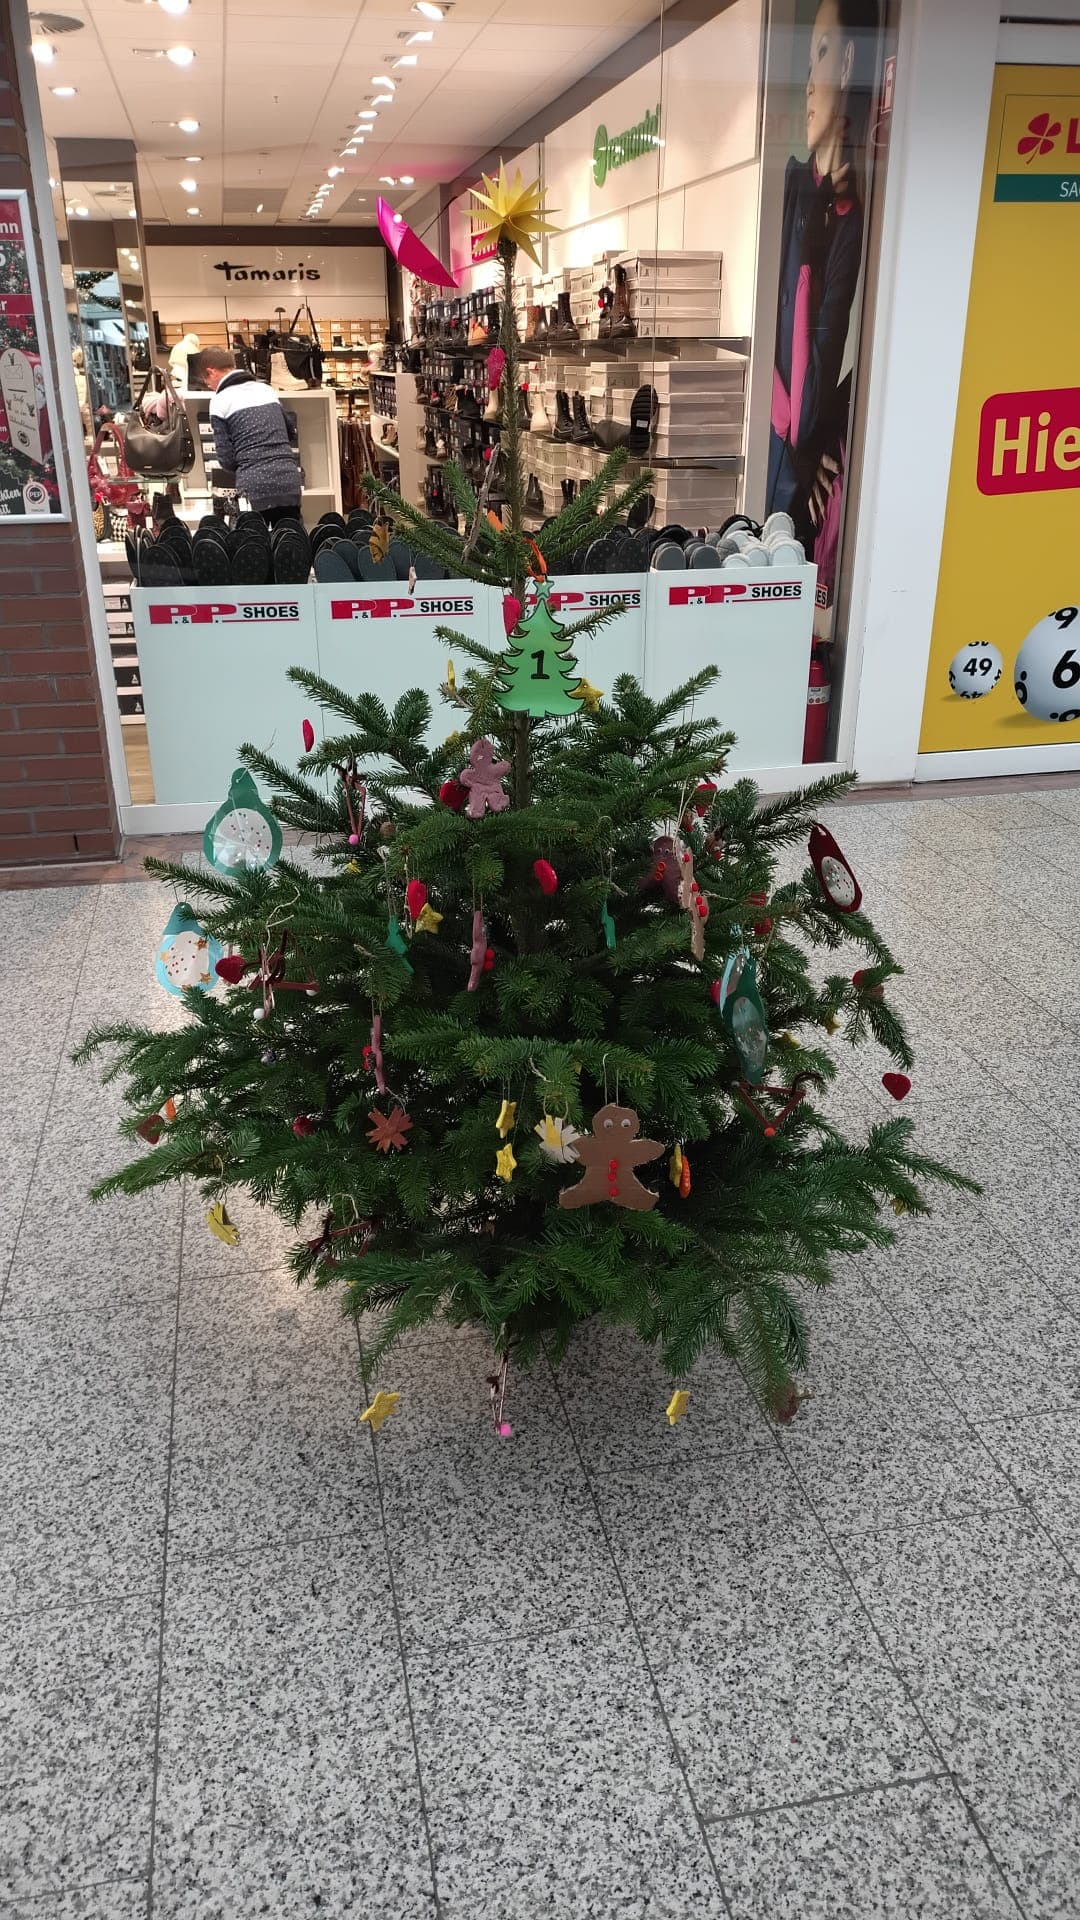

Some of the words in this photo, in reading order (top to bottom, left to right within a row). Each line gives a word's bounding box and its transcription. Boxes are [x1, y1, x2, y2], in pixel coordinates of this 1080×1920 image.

[1060, 181, 1080, 198] SA
[213, 261, 321, 281] Tamaris
[751, 585, 802, 598] SHOES
[420, 600, 474, 613] SHOES
[589, 593, 641, 607] SHOES
[243, 606, 299, 618] SHOES
[530, 649, 550, 680] 1
[963, 658, 993, 677] 49
